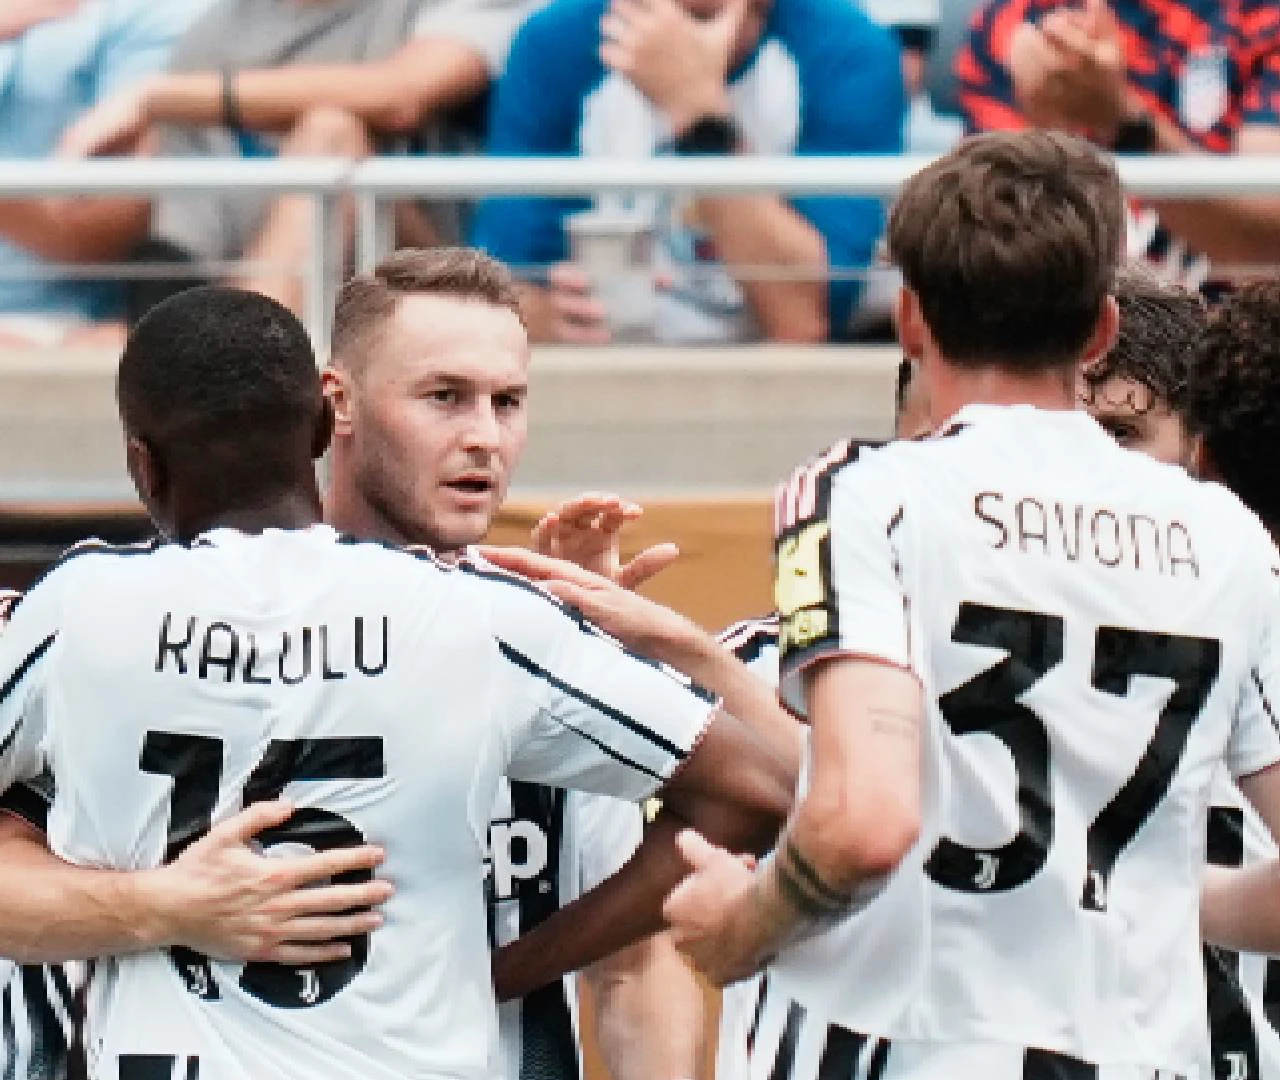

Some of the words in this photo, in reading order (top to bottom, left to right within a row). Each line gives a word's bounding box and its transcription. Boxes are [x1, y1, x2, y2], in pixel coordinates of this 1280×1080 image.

[974, 490, 1200, 579] SAVONA
[154, 611, 392, 685] KALULU
[922, 600, 1223, 912] 37
[139, 729, 386, 1010] 15
